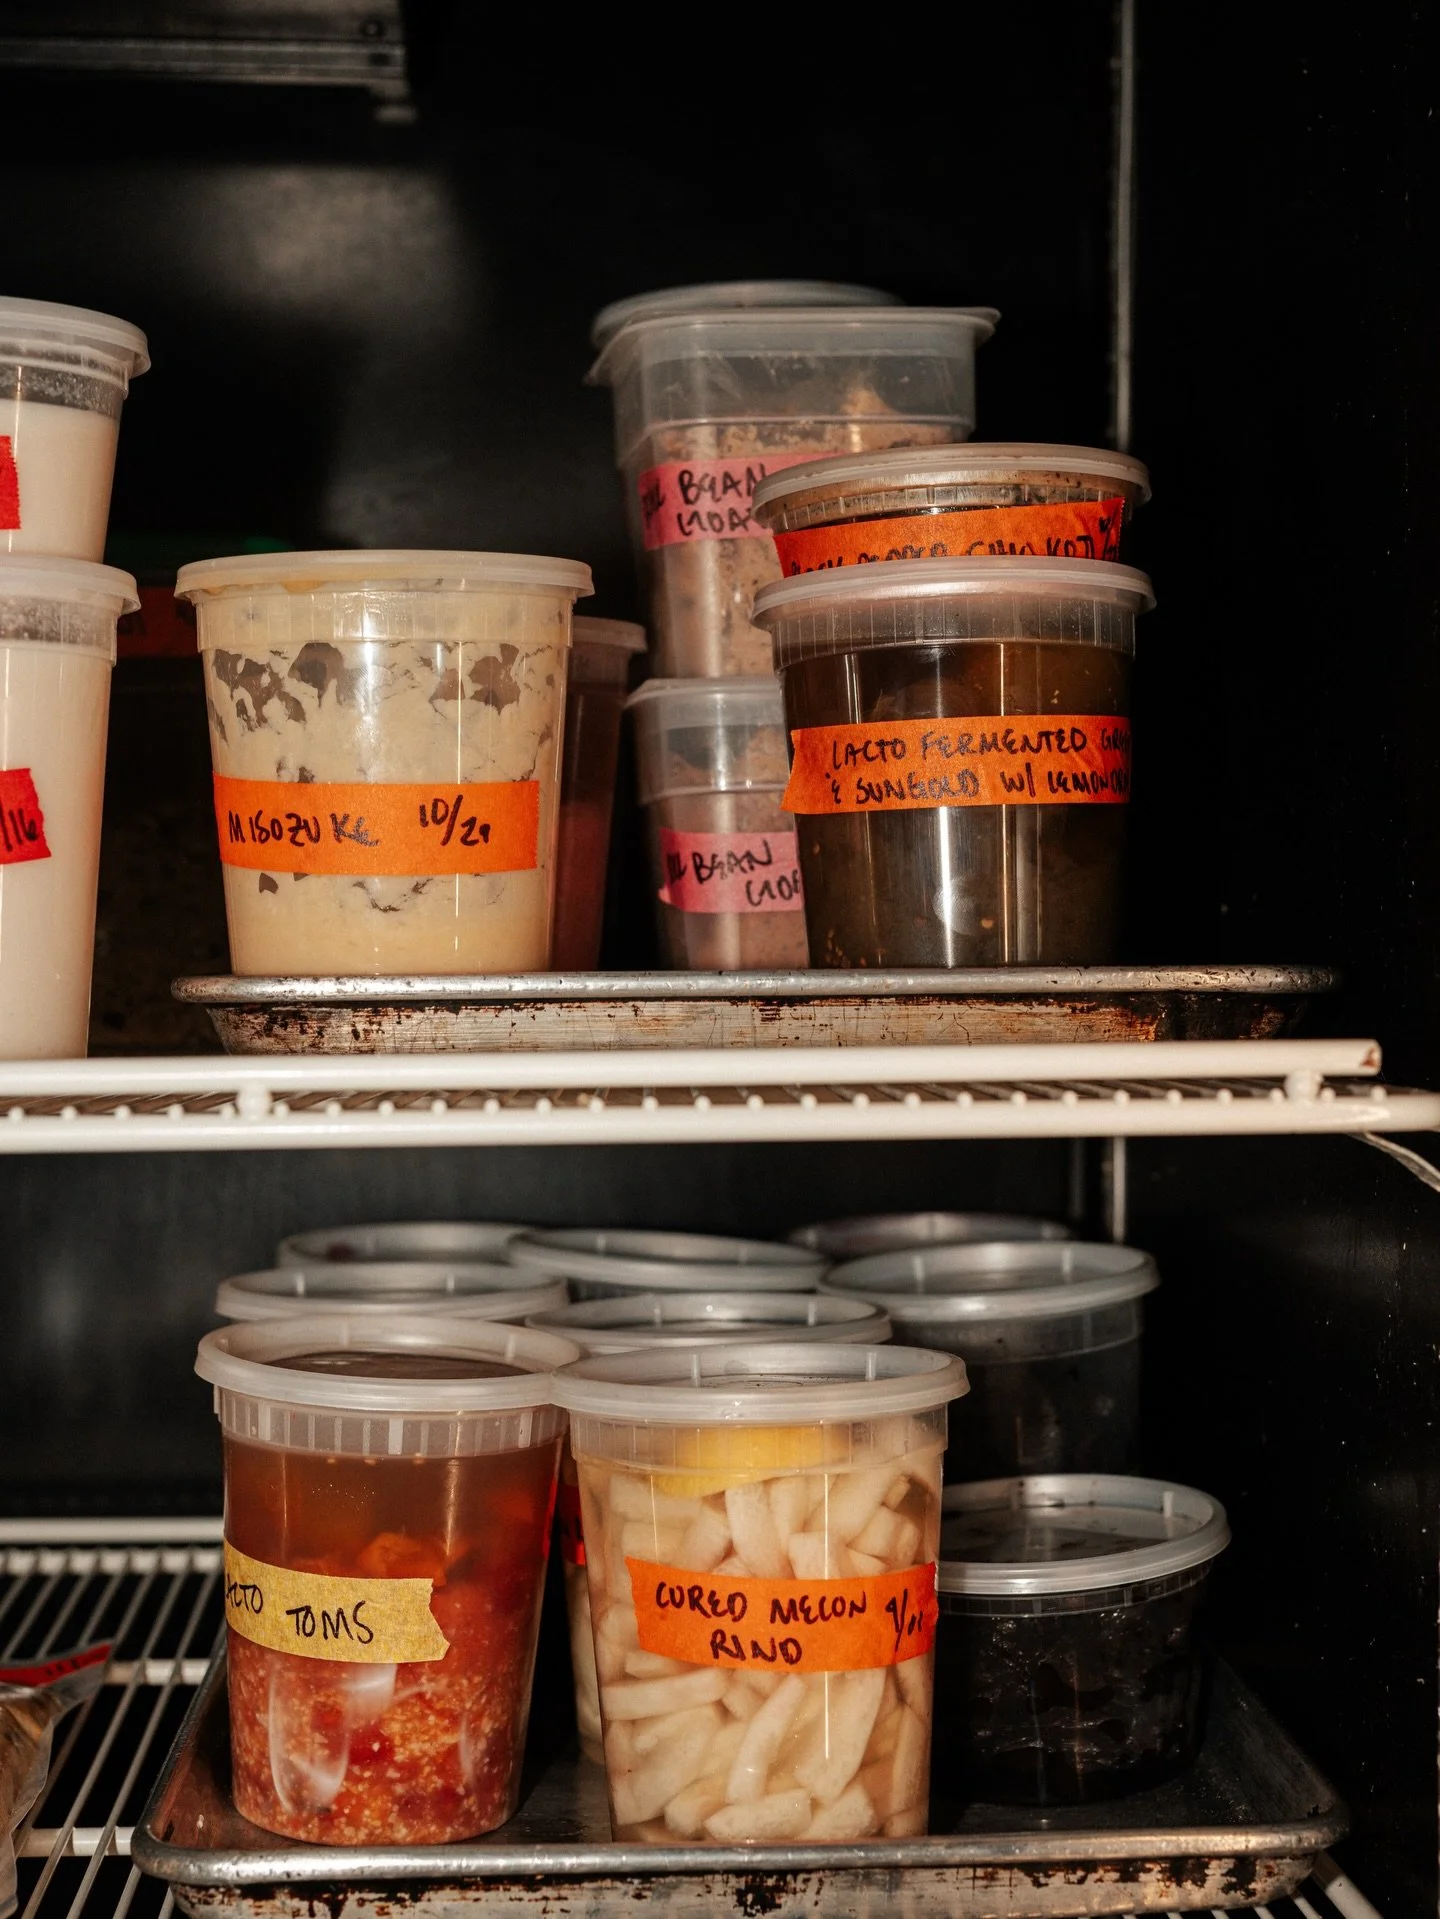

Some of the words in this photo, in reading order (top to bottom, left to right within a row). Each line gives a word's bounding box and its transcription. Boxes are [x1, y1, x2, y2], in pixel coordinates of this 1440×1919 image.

[678, 463, 768, 505] BEAN
[832, 737, 906, 770] LACTO
[920, 726, 1088, 761] FERMENTED
[856, 768, 980, 804] SUNGOLD
[692, 838, 773, 885] BEAN
[286, 1600, 374, 1645] TOMS
[655, 1581, 748, 1622] CURED
[769, 1590, 867, 1625] MELON
[710, 1628, 803, 1665] RIND
